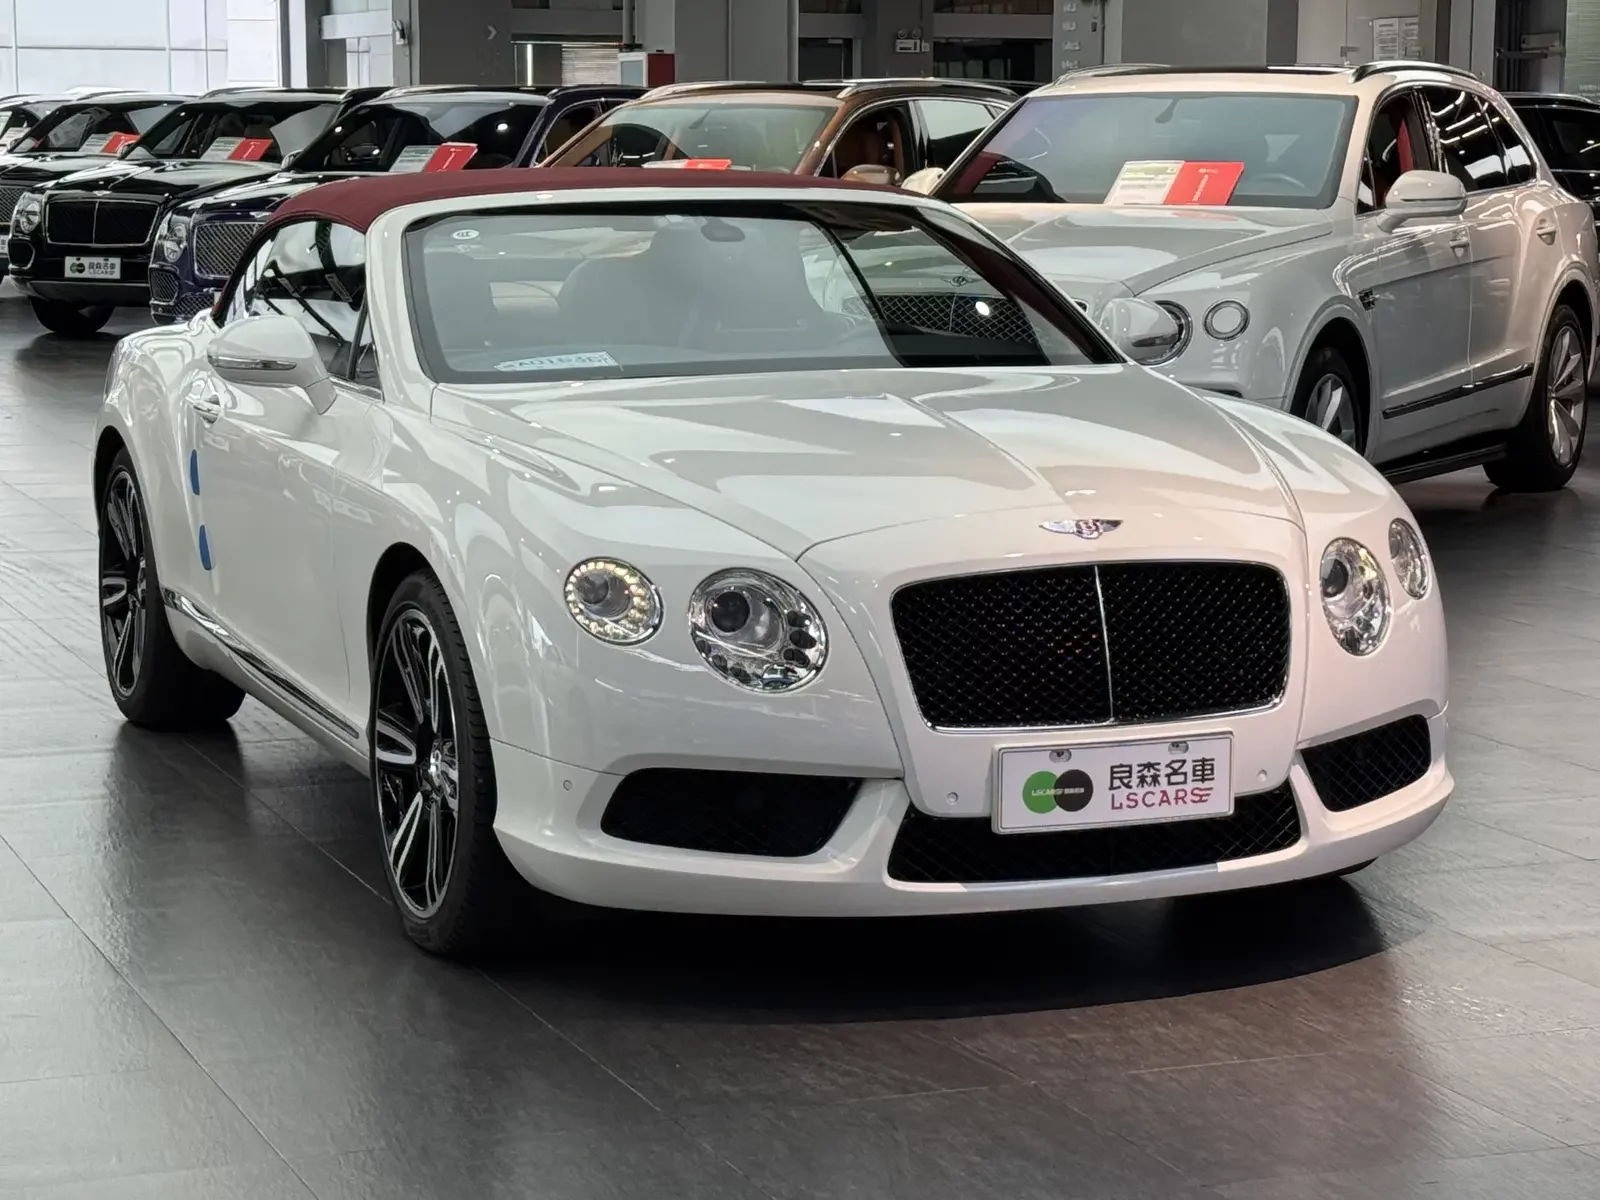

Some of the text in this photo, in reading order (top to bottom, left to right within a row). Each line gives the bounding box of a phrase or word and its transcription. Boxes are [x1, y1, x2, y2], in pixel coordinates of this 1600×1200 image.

[1108, 757, 1215, 791] 良森名車
[1111, 786, 1214, 811] LSCARS
